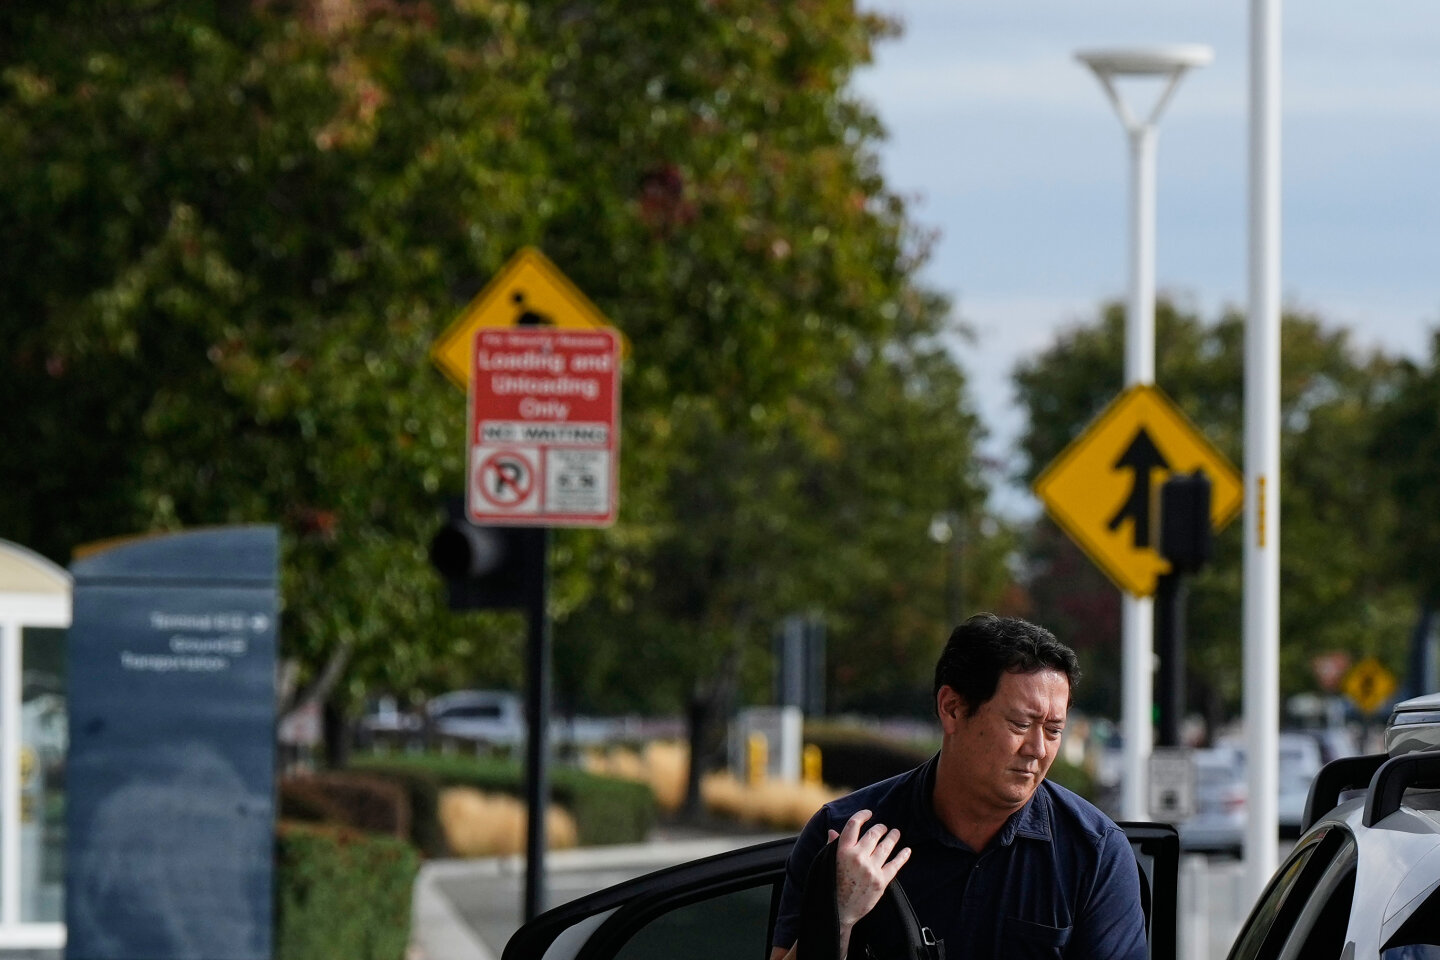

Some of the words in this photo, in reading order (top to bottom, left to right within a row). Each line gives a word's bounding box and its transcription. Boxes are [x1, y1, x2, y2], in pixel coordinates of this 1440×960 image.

[479, 349, 565, 375] Loading
[571, 353, 611, 372] and
[492, 373, 599, 400] Unloading
[519, 398, 570, 420] Only
